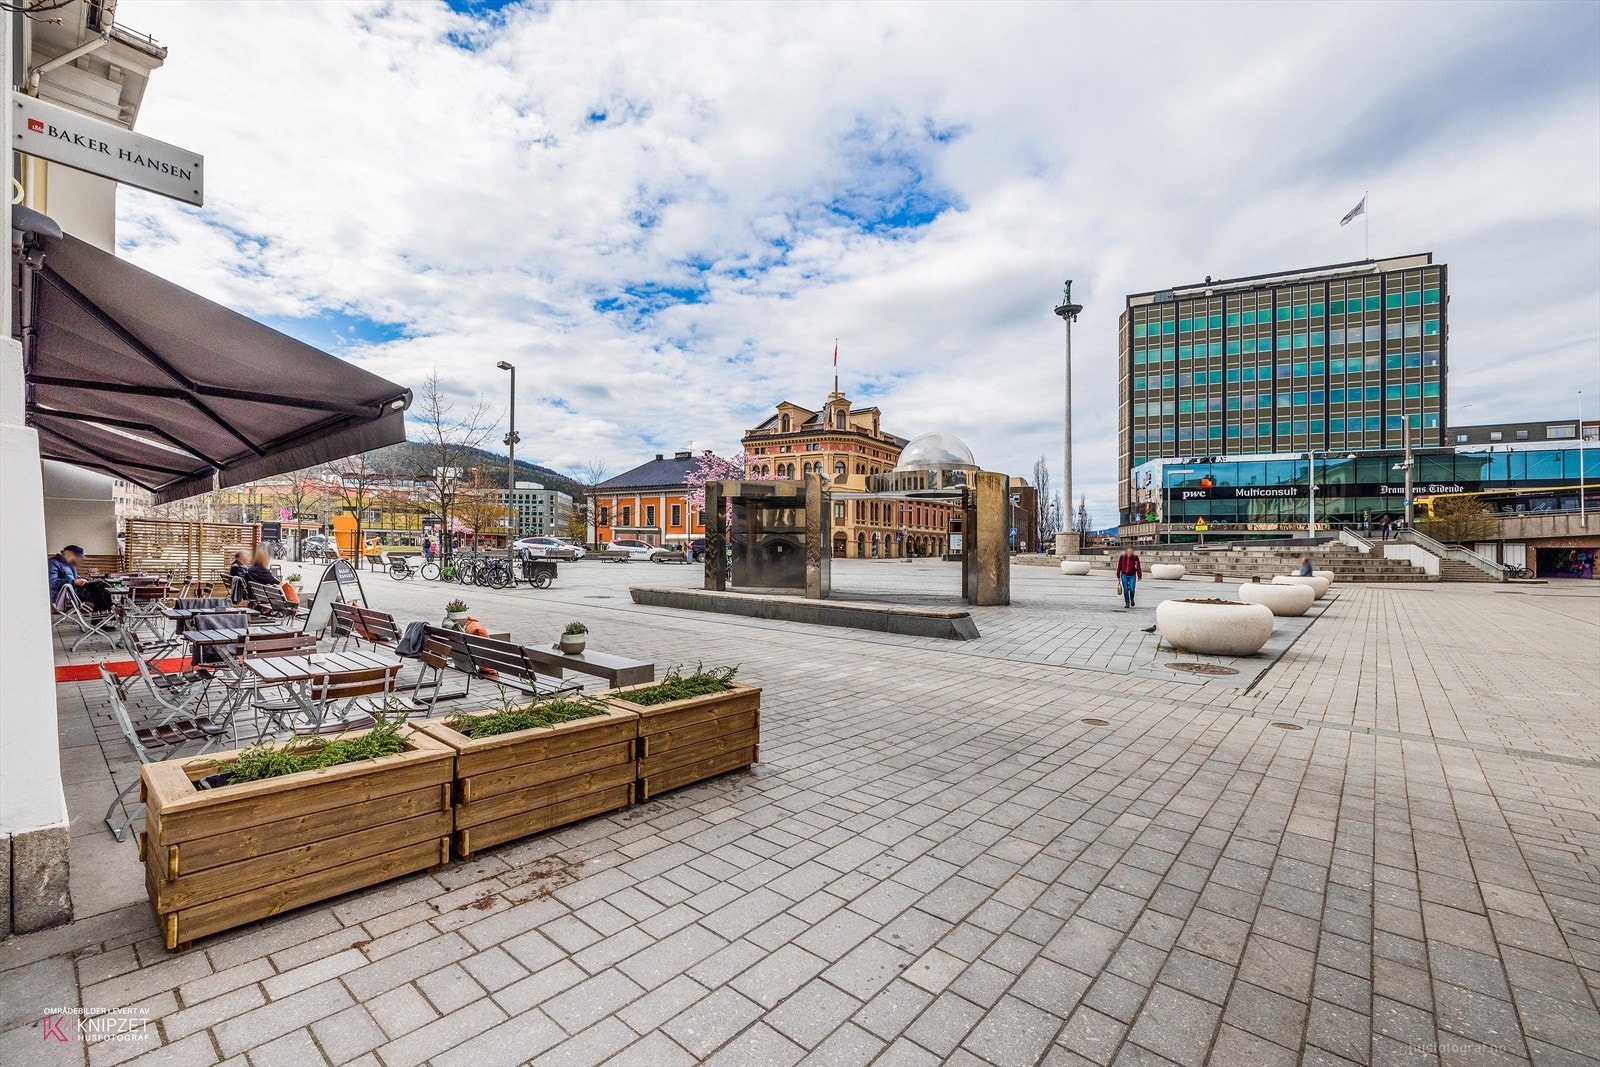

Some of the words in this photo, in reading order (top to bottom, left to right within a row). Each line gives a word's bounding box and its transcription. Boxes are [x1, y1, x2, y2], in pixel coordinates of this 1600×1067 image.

[47, 124, 112, 156] BAKER
[118, 147, 192, 181] HANSEN
[1235, 486, 1298, 497] Multiconsult
[1380, 484, 1427, 494] Dramens
[1428, 483, 1465, 494] Tidende
[1182, 490, 1207, 500] pwc
